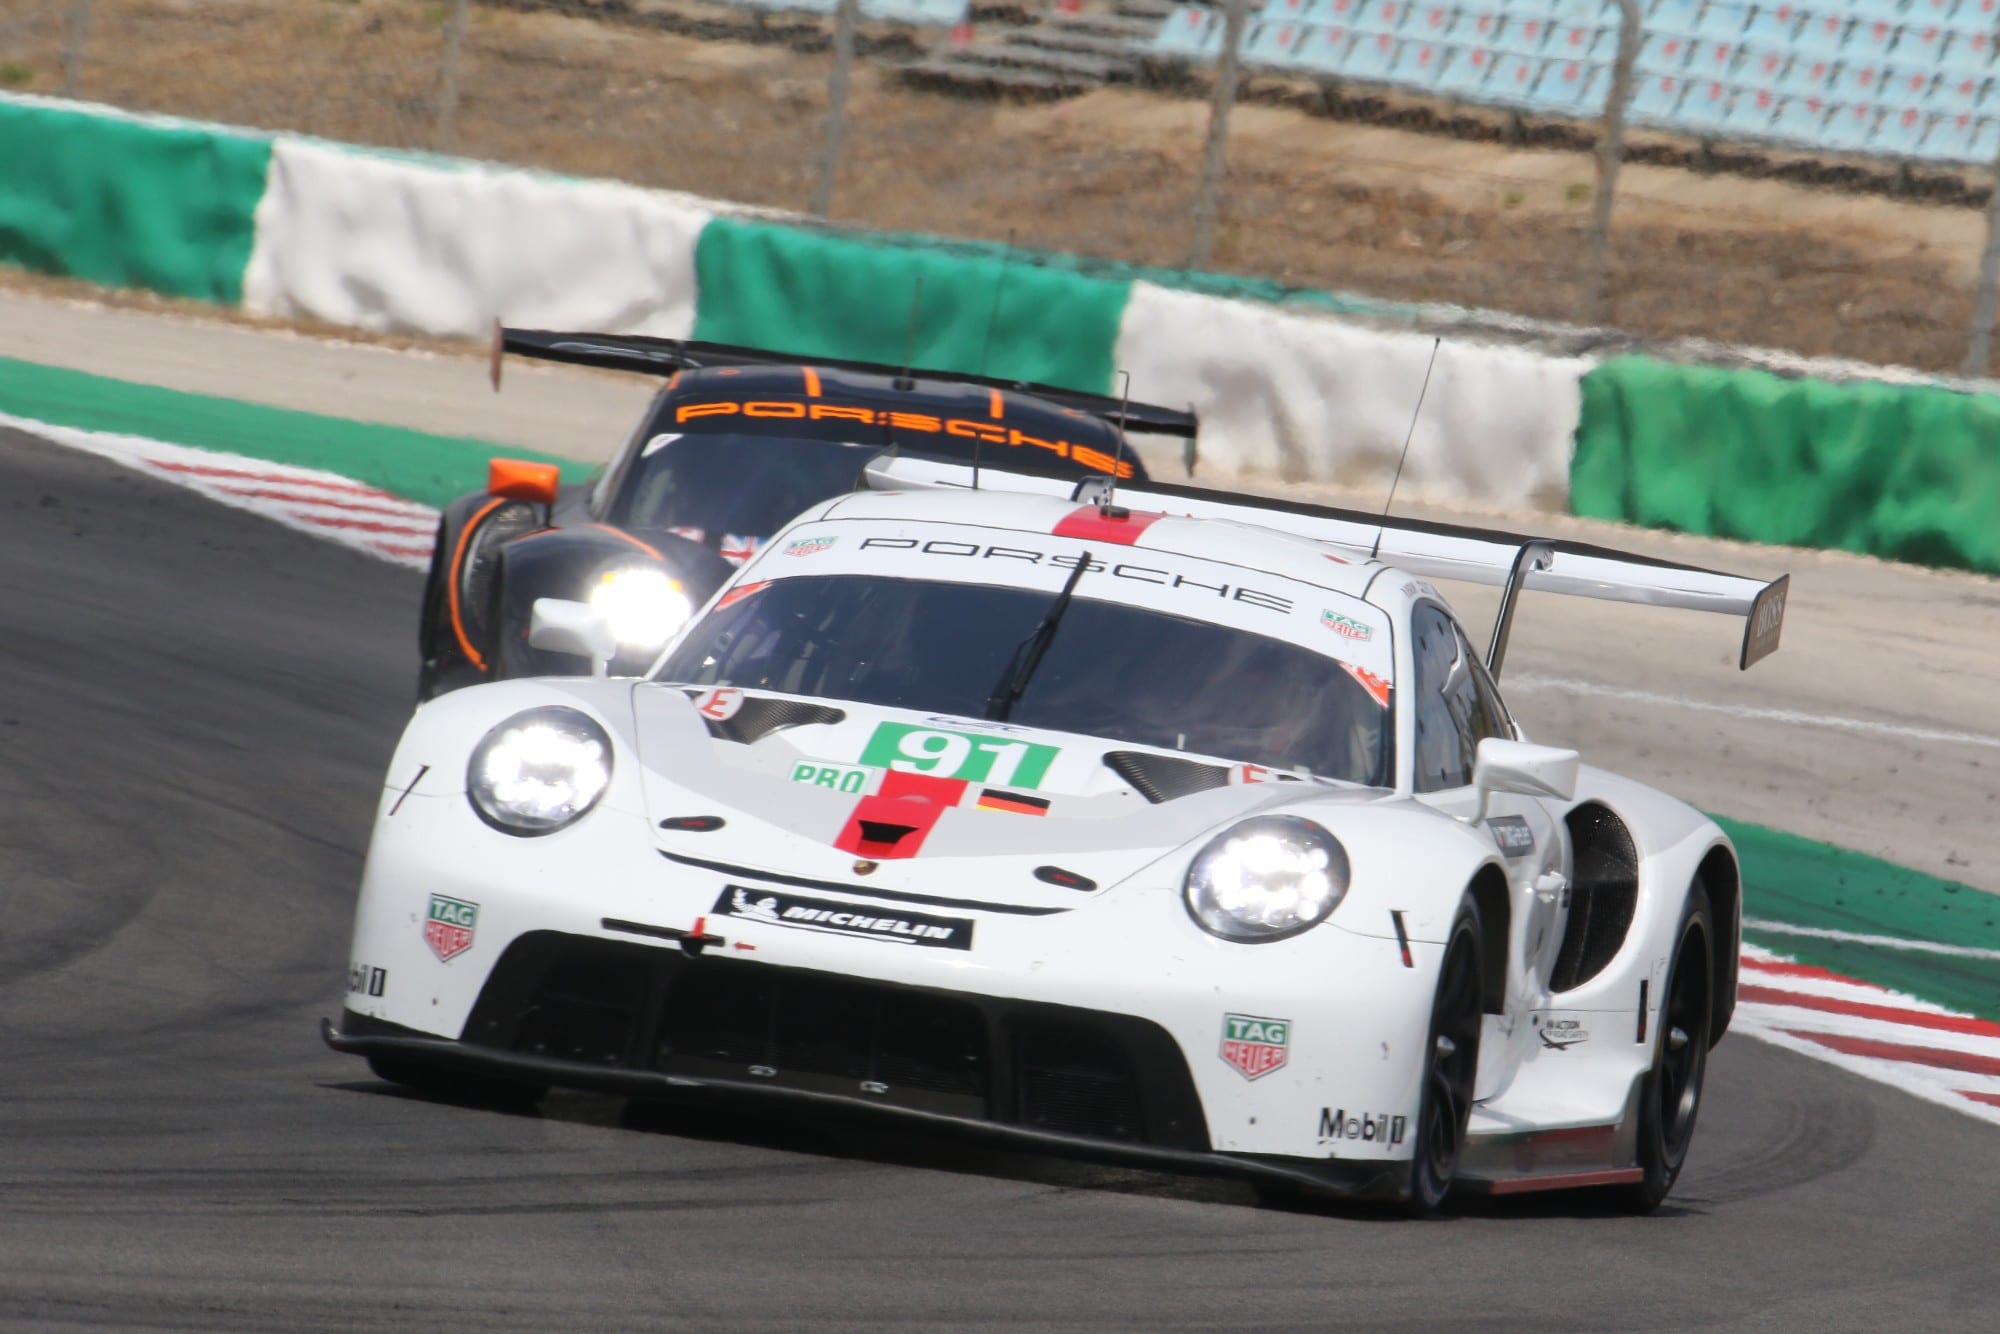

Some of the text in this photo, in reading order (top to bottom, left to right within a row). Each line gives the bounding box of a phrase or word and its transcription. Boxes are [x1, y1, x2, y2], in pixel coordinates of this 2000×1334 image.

[676, 402, 1134, 479] PORSCHE
[859, 538, 1294, 615] PORSCHE
[701, 687, 738, 718] E
[889, 730, 1030, 788] 91
[792, 764, 867, 794] PRO
[431, 901, 474, 926] TAG
[782, 905, 955, 940] MICHELIN
[424, 923, 473, 957] HEUER
[1230, 1020, 1285, 1043] TAG
[1223, 1041, 1285, 1074] HEUER
[1319, 1107, 1389, 1143] Mobil
